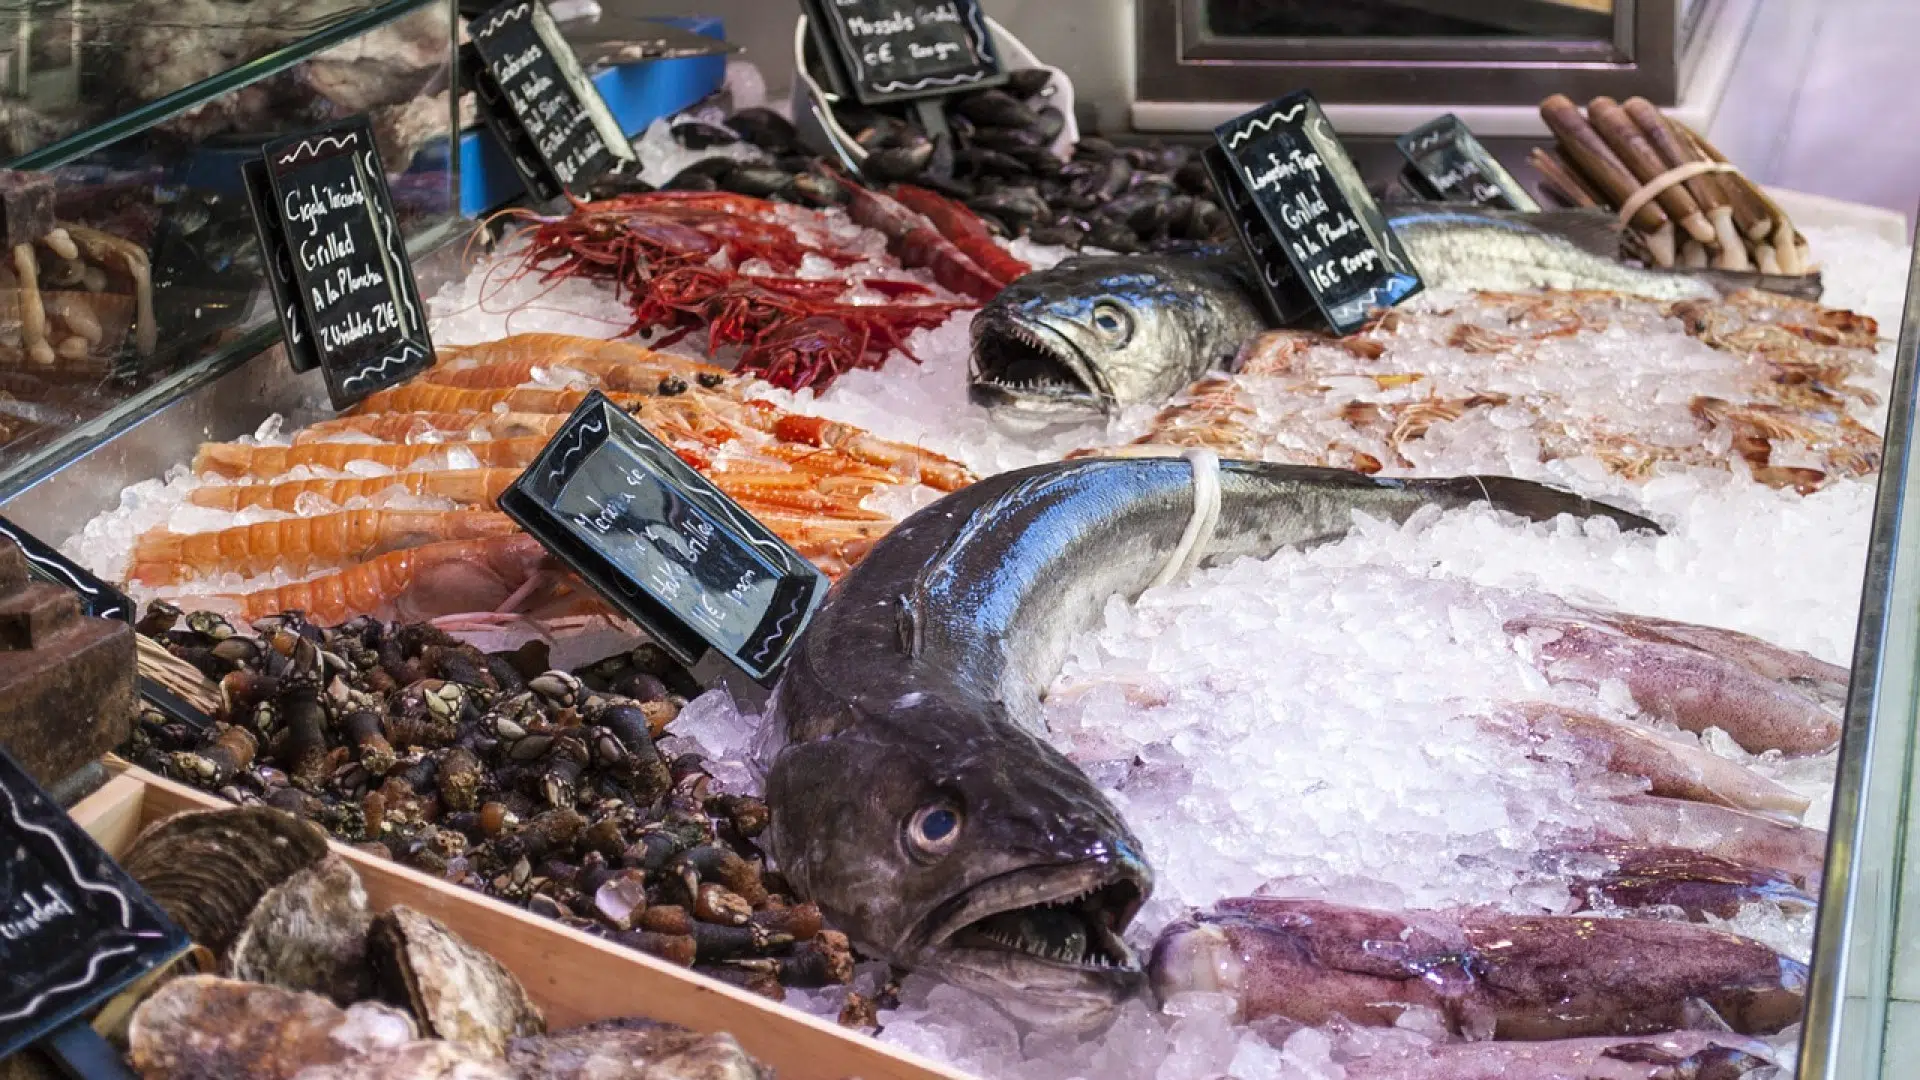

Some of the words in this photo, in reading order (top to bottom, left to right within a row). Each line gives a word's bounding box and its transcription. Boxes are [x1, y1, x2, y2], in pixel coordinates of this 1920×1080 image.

[1280, 184, 1329, 230] Grilled
[300, 222, 355, 271] Grilled
[312, 287, 325, 312] A
[325, 279, 340, 305] la
[338, 263, 383, 301] Plancha
[1309, 259, 1341, 293] 16€
[320, 328, 334, 352] 2
[616, 464, 647, 486] de
[677, 508, 715, 563] Grilled
